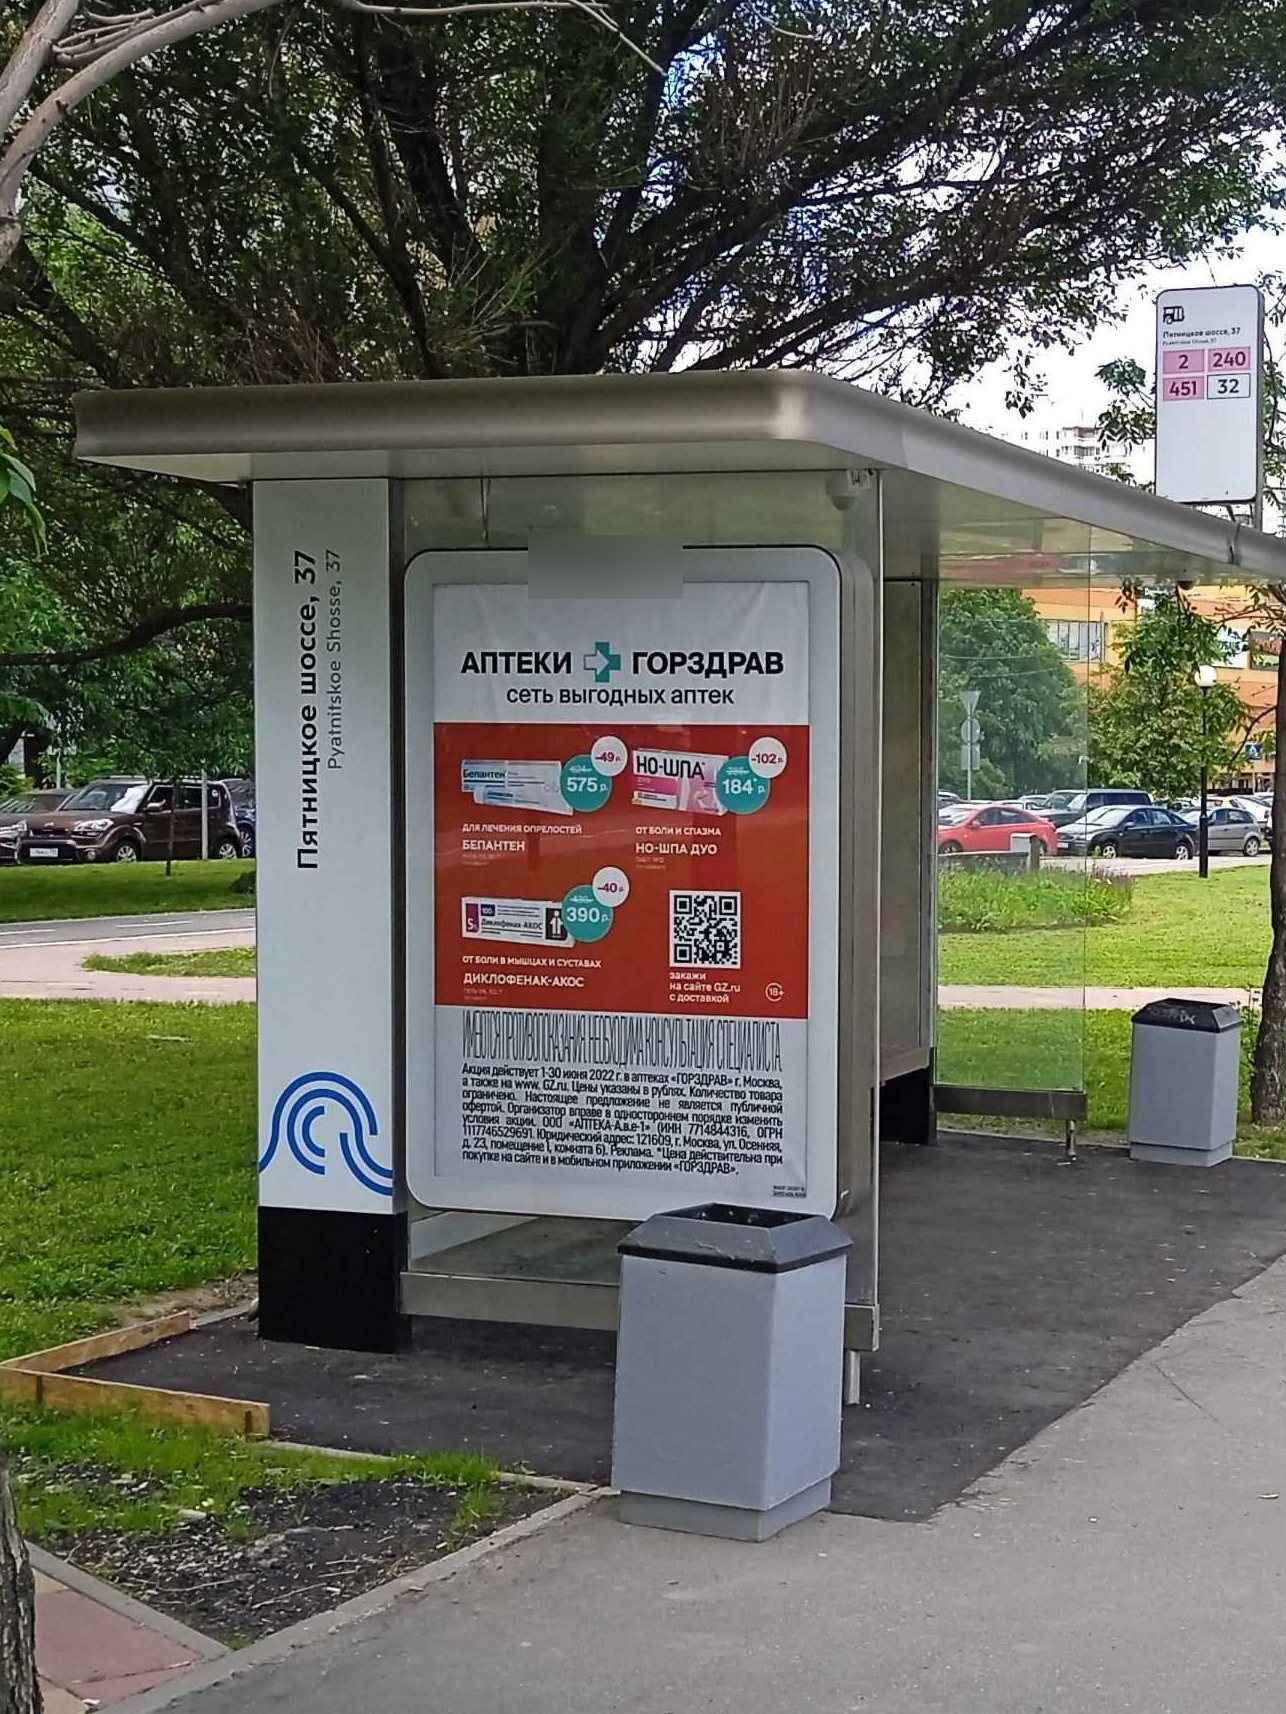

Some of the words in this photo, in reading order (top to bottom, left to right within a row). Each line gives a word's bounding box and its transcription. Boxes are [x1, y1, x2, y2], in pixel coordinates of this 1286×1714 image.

[1231, 327, 1240, 335] 37
[1179, 354, 1189, 369] 2
[1213, 351, 1246, 367] 240
[1169, 380, 1197, 396] 451
[1218, 379, 1239, 394] 32
[294, 549, 316, 585] 37
[326, 549, 341, 572] 37
[326, 580, 344, 653] Shosse,
[300, 595, 320, 695] шоссе,
[460, 651, 572, 675] АПТЕКИ
[632, 651, 784, 679] ГОРЗДРАВ
[506, 687, 554, 705] сеть
[558, 686, 665, 708] выгодных
[670, 687, 734, 708] аптек
[326, 657, 345, 770] Pyatnitskoe
[297, 704, 320, 869] Пятницкое
[566, 777, 598, 792] 575
[462, 823, 481, 833] ДЛЯ
[482, 824, 522, 834] ЛЕЧЕНИЯ
[523, 824, 582, 834] ОПРЕЛОСТЕЙ
[635, 826, 648, 835] ОТ
[649, 827, 674, 835] БОЛИ
[675, 827, 682, 835] И
[684, 827, 721, 836] СПАЗМА
[462, 840, 525, 851] БЕПАНТЕН
[635, 843, 688, 854] НО-ШПА
[690, 844, 718, 856] ДУО
[566, 907, 600, 922] 390
[462, 955, 474, 963] ОТ
[475, 956, 499, 965] БОЛИ
[500, 956, 506, 965] В
[507, 957, 548, 967] МЫШЦАХ
[549, 958, 556, 966] И
[557, 959, 602, 968] СУСТАВАХ
[463, 972, 585, 987] ДИКЛОФЕНАК-АКОС
[669, 972, 706, 980] закажи
[669, 982, 681, 990] на
[683, 982, 712, 991] сайте
[677, 994, 730, 1003] доставкой
[462, 1063, 490, 1076] Акция
[492, 1064, 539, 1079] действует
[541, 1066, 561, 1078] 1-30
[563, 1069, 588, 1079] июня
[589, 1069, 614, 1081] 2022
[624, 1073, 630, 1082] в
[631, 1073, 669, 1084] аптеках
[671, 1073, 733, 1087] «ГОРЗДРАВ»
[734, 1078, 742, 1087] г.
[743, 1076, 782, 1090] Москва,
[462, 1078, 468, 1086] а
[470, 1078, 499, 1088] также
[501, 1079, 512, 1089] на
[572, 1081, 598, 1093] Цены
[600, 1084, 640, 1096] указаны
[643, 1086, 649, 1095] в
[689, 1086, 746, 1099] Количество
[748, 1091, 783, 1103] товара
[525, 1091, 578, 1105] Настоящее
[586, 1095, 650, 1108] предложение
[659, 1099, 670, 1108] не
[679, 1100, 722, 1111] является
[731, 1100, 783, 1114] публичной
[508, 1102, 566, 1116] Организатор
[569, 1107, 602, 1119] вправе
[605, 1109, 612, 1118] в
[614, 1111, 688, 1123] одностороннем
[692, 1113, 732, 1126] порядке
[735, 1115, 783, 1126] изменить
[462, 1114, 500, 1126] условия
[543, 1116, 562, 1128] ООО
[757, 1126, 783, 1139] ОГРН
[537, 1128, 602, 1143] Юридический
[683, 1136, 721, 1150] Москва,
[462, 1151, 499, 1163] покупке
[501, 1153, 512, 1162] на
[514, 1152, 541, 1163] сайте
[543, 1155, 549, 1164] и
[550, 1156, 557, 1164] в
[558, 1155, 610, 1168] мобильном
[613, 1159, 672, 1171] приложении
[491, 1140, 544, 1152] помещение
[555, 1144, 593, 1155] комната
[689, 1149, 762, 1164] действительна
[764, 1154, 783, 1167] при
